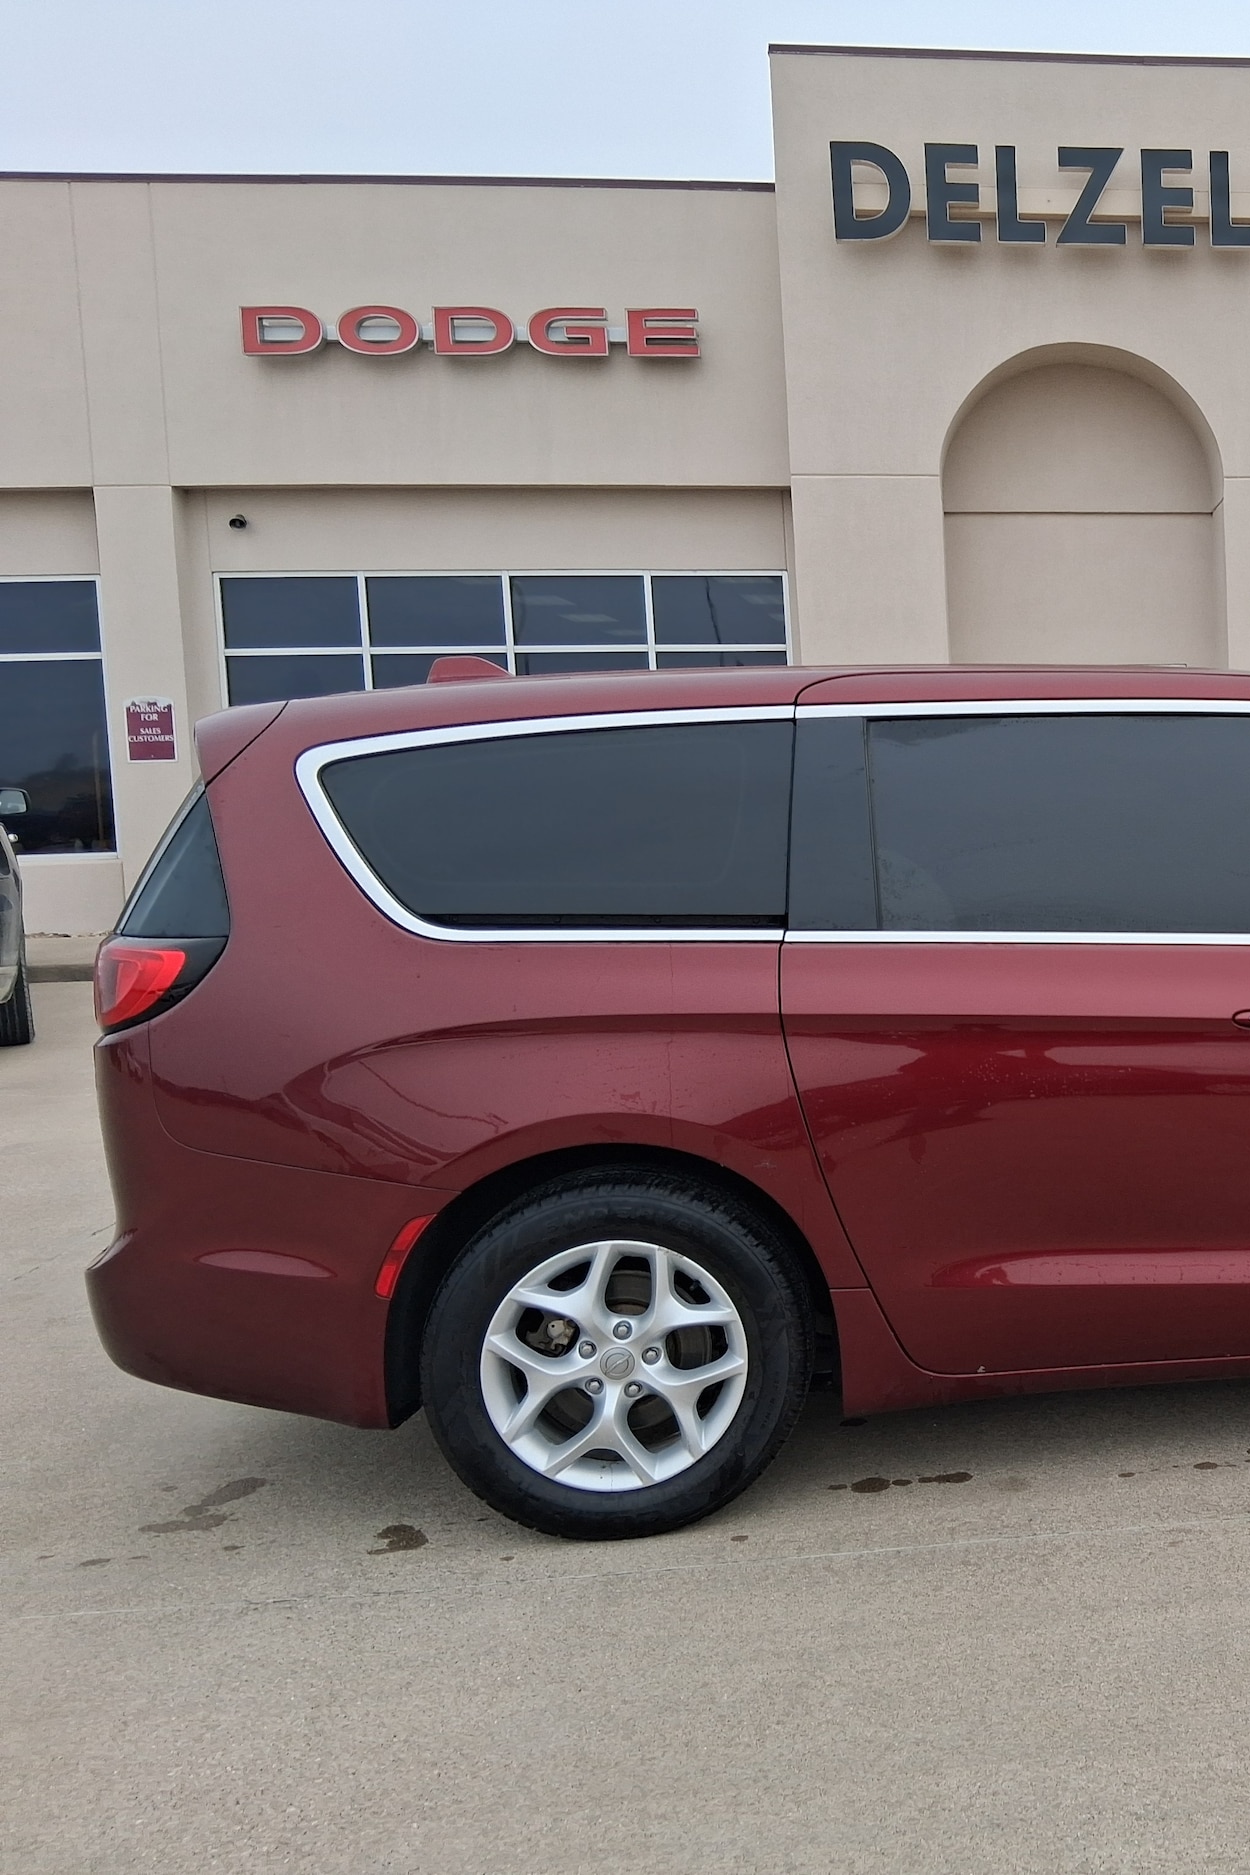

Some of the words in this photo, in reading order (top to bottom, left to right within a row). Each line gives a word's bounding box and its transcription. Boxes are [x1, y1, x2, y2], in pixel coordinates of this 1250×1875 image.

[239, 305, 702, 358] DODGE
[129, 705, 168, 713] PARKING
[141, 713, 159, 721] FOR
